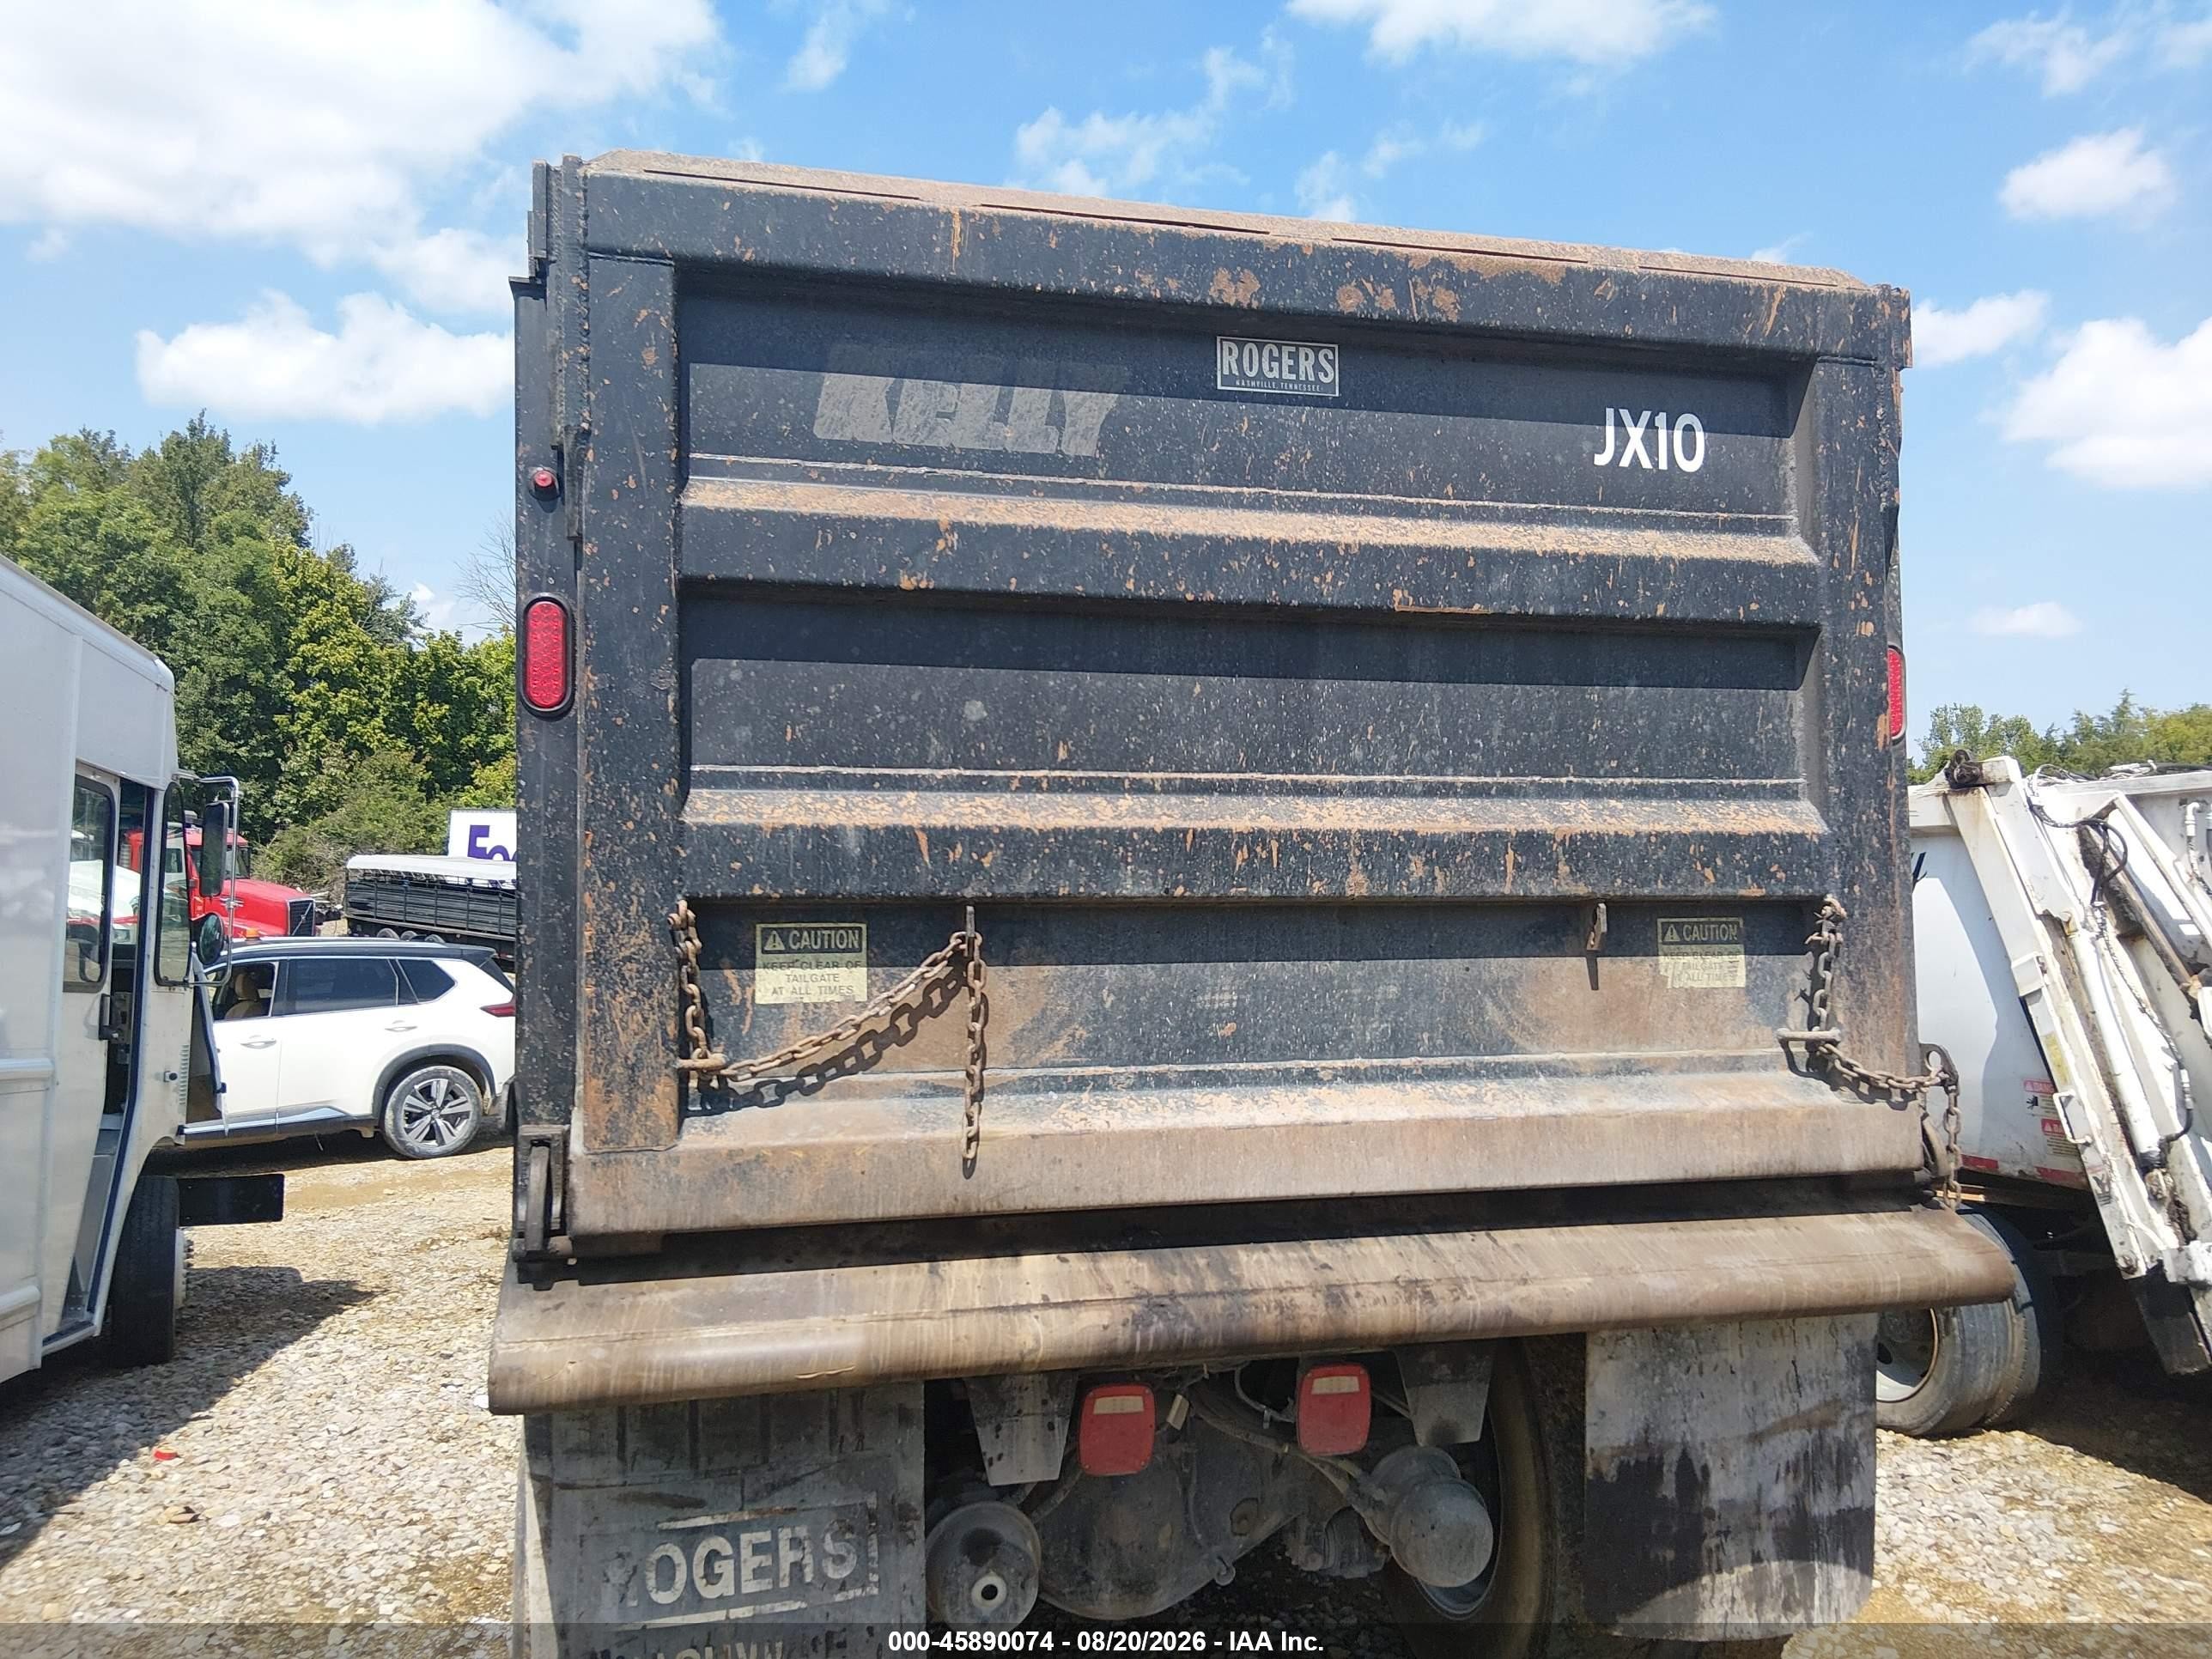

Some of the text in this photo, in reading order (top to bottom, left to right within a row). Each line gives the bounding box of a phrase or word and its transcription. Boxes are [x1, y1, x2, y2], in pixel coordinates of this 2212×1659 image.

[1222, 341, 1334, 383] ROGERS
[1280, 382, 1321, 392] TENNESSEE
[1594, 407, 1705, 472] JX10
[788, 929, 860, 950] CAUTION
[1682, 923, 1738, 942] CAUTION
[763, 959, 861, 972] KEEP CLEAR OF
[785, 973, 841, 984] TAILGATE
[772, 985, 854, 997] AT ALL TIMES
